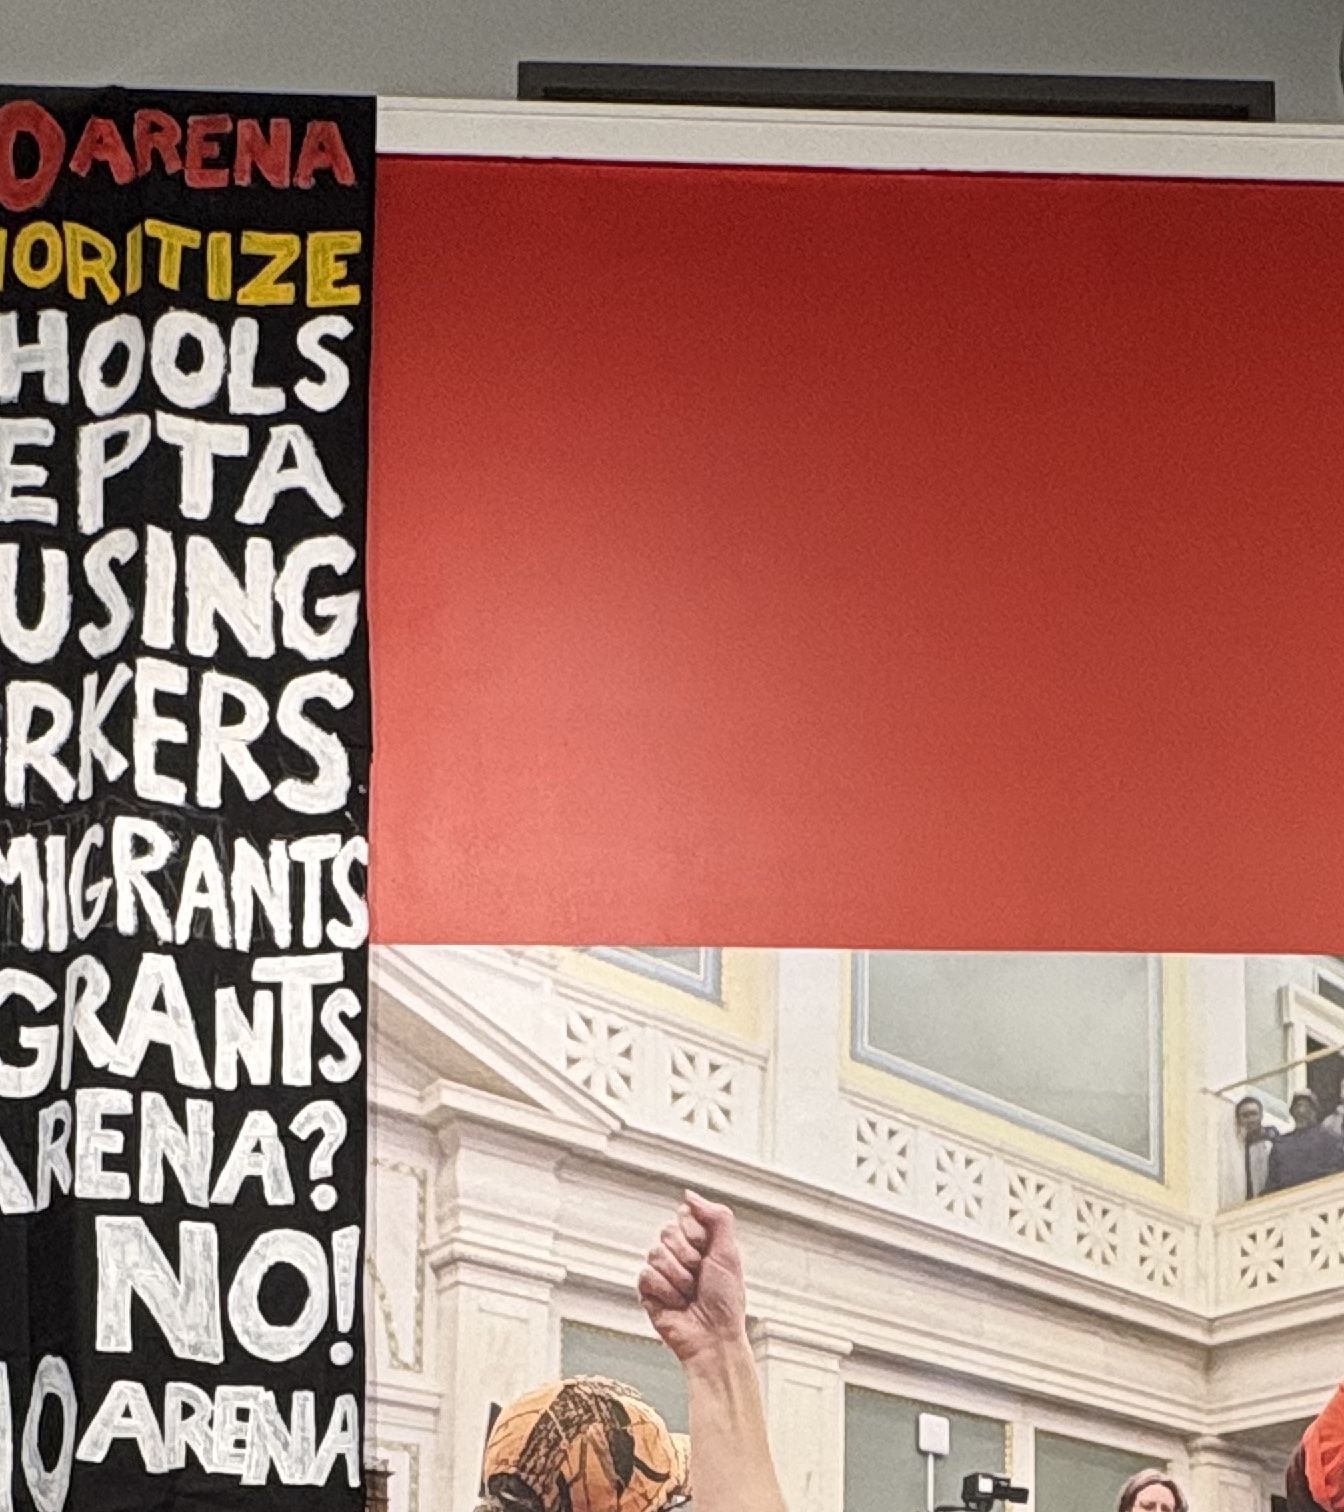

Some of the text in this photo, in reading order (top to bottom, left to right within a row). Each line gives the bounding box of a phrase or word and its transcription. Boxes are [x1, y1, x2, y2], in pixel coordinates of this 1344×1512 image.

[68, 109, 356, 188] ARENA
[95, 1215, 360, 1366] NO!
[75, 1381, 360, 1486] ARENA
